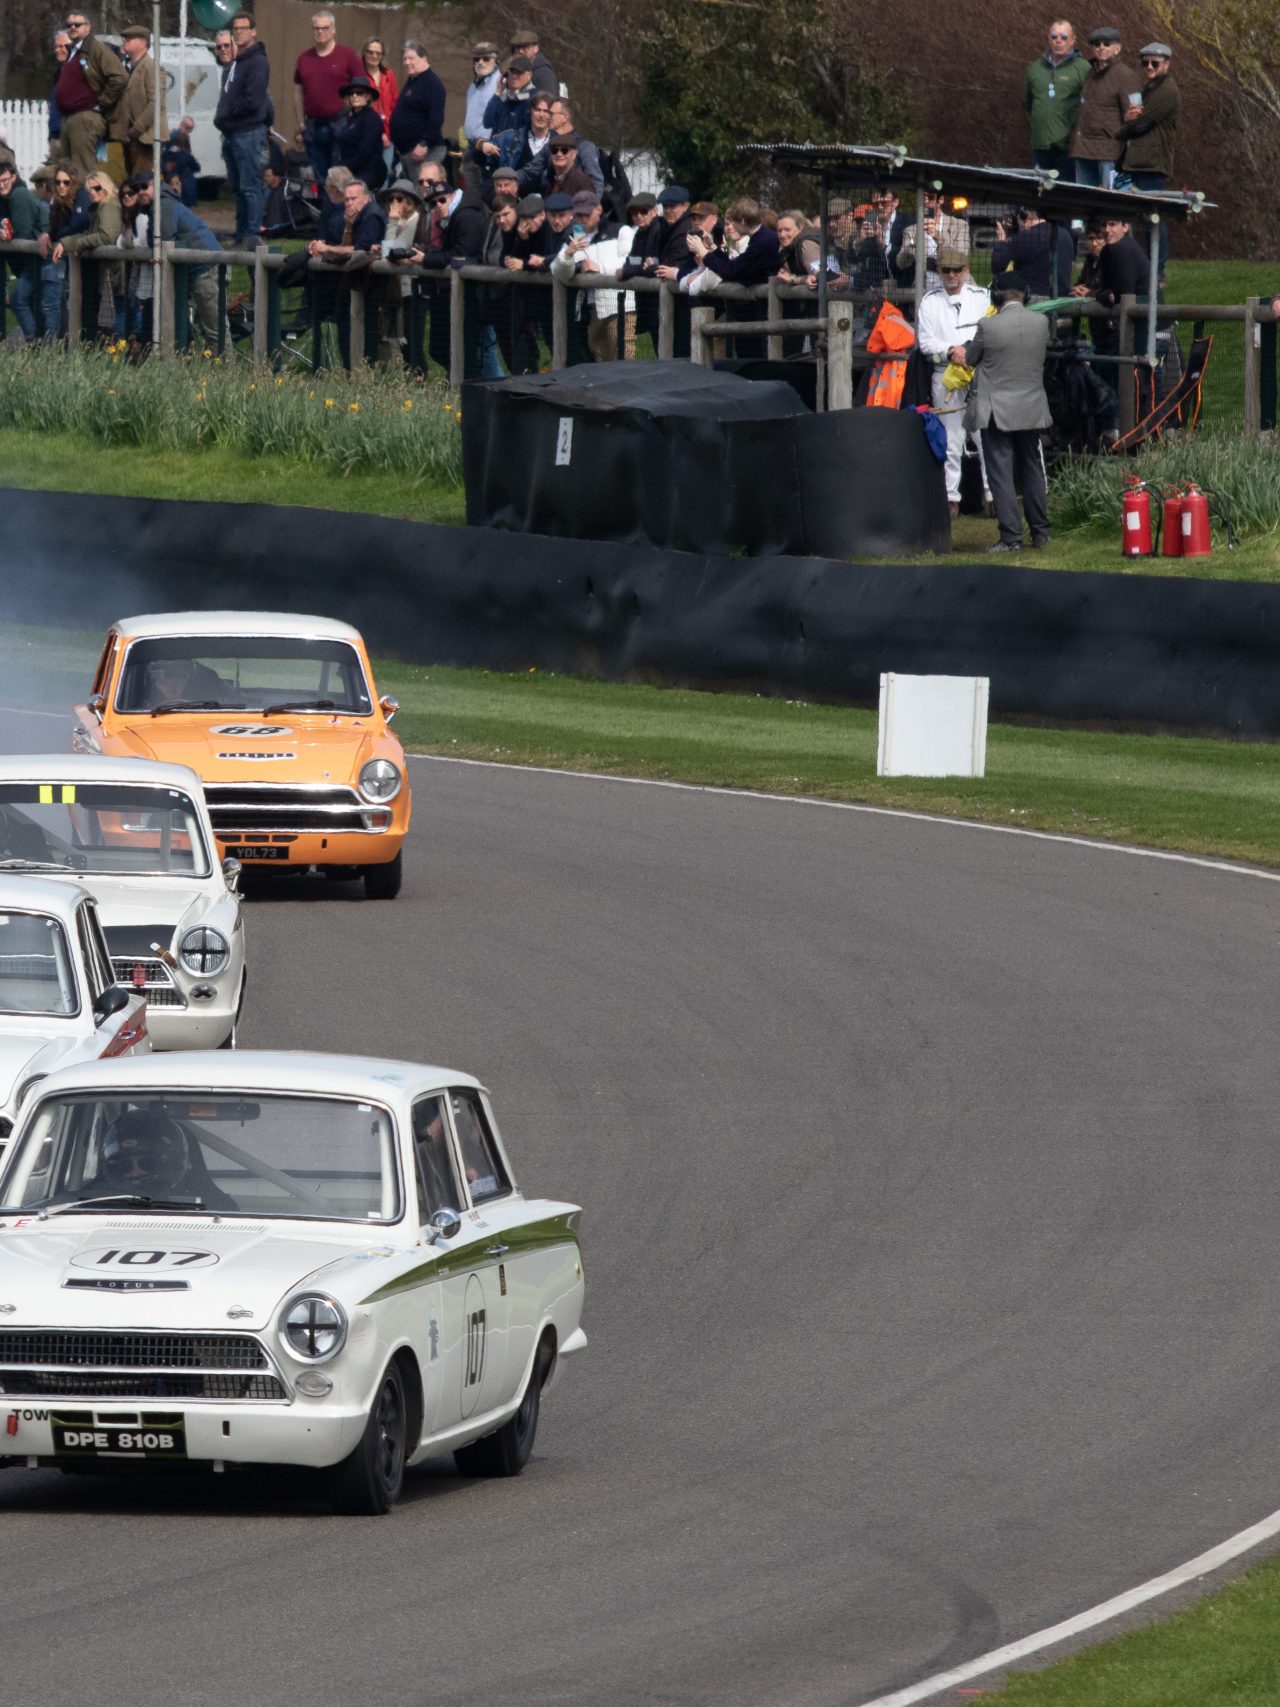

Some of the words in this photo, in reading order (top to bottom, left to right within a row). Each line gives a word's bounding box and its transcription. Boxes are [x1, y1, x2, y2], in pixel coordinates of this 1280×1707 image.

[218, 726, 286, 735] 68
[96, 1250, 211, 1266] 107
[96, 1281, 155, 1289] LOTUS
[464, 1308, 486, 1388] 107
[12, 1409, 50, 1421] TOW
[63, 1431, 109, 1448] DPE
[118, 1433, 175, 1449] 810B
